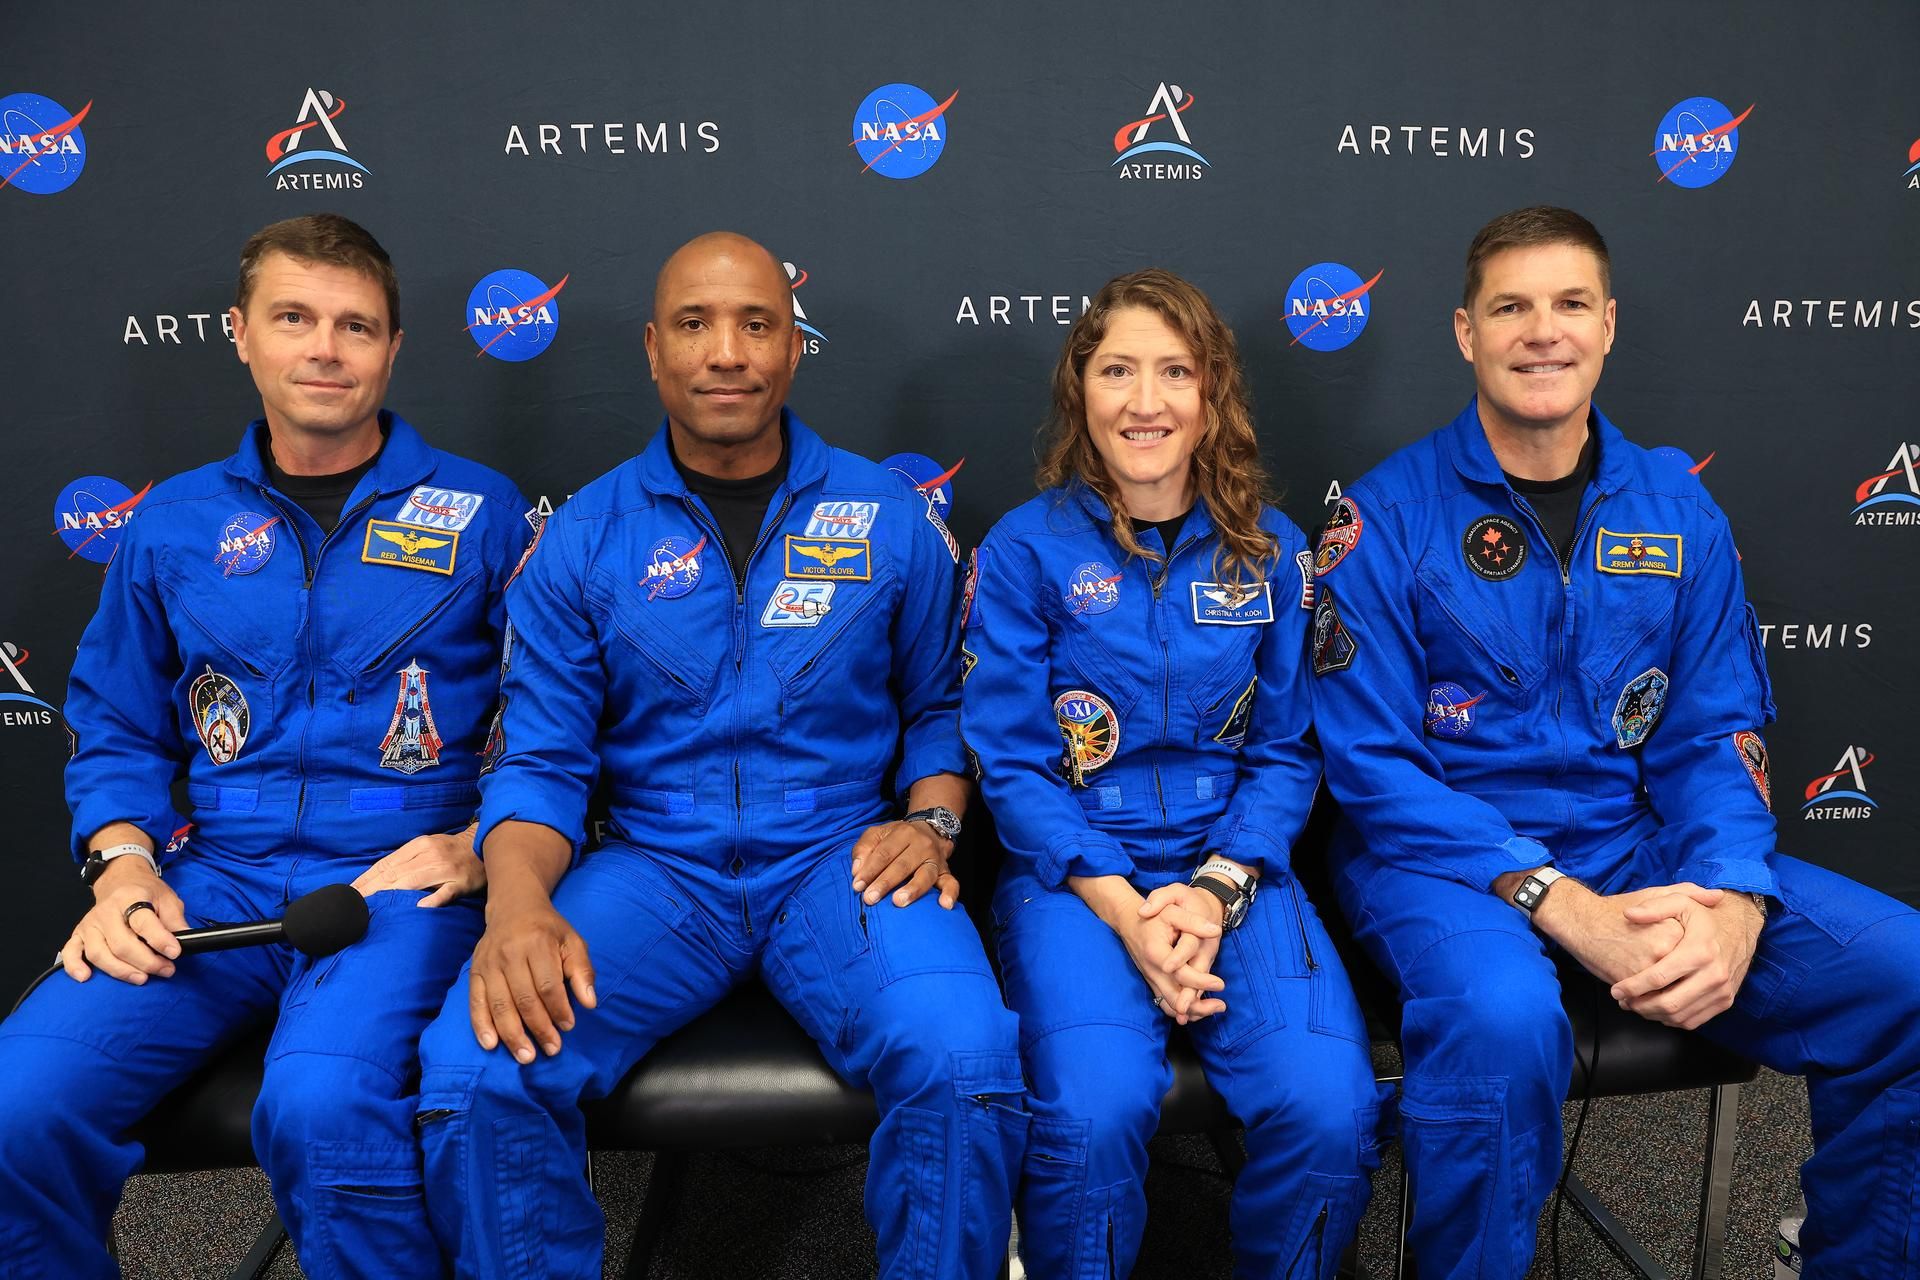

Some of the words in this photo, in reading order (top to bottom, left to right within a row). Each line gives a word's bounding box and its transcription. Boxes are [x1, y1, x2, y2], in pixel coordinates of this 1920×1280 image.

[505, 122, 720, 155] ARTEMIS
[861, 122, 941, 141] NASA
[0, 134, 81, 155] NASA
[1338, 125, 1535, 159] ARTEMIS
[1660, 133, 1733, 154] NASA
[276, 173, 363, 190] ARTEMIS
[1120, 164, 1202, 180] ARTEMIS
[473, 306, 555, 326] NASA
[955, 296, 1091, 325] ARTE
[1291, 299, 1365, 318] NASA
[124, 313, 236, 345] ARTE
[1467, 522, 1483, 544] CANADIAN
[1500, 520, 1518, 534] AGENCY
[219, 530, 272, 555] NASA
[380, 551, 397, 560] REID
[401, 553, 436, 567] WISEMAN
[647, 556, 700, 578] NASA
[1610, 560, 1636, 568] JEREMY
[1639, 560, 1667, 570] HANSEN
[802, 566, 826, 575] VICTOR
[829, 567, 855, 576] GLOVER
[1071, 581, 1119, 597] NASA
[1204, 609, 1233, 618] CHRISTINA
[1758, 623, 1873, 649] TEMIS
[0, 710, 52, 726] EMIS
[1064, 702, 1092, 718] LXI
[1426, 701, 1471, 722] NASA
[213, 734, 232, 754] XL
[1804, 806, 1871, 820] ARTEMIS
